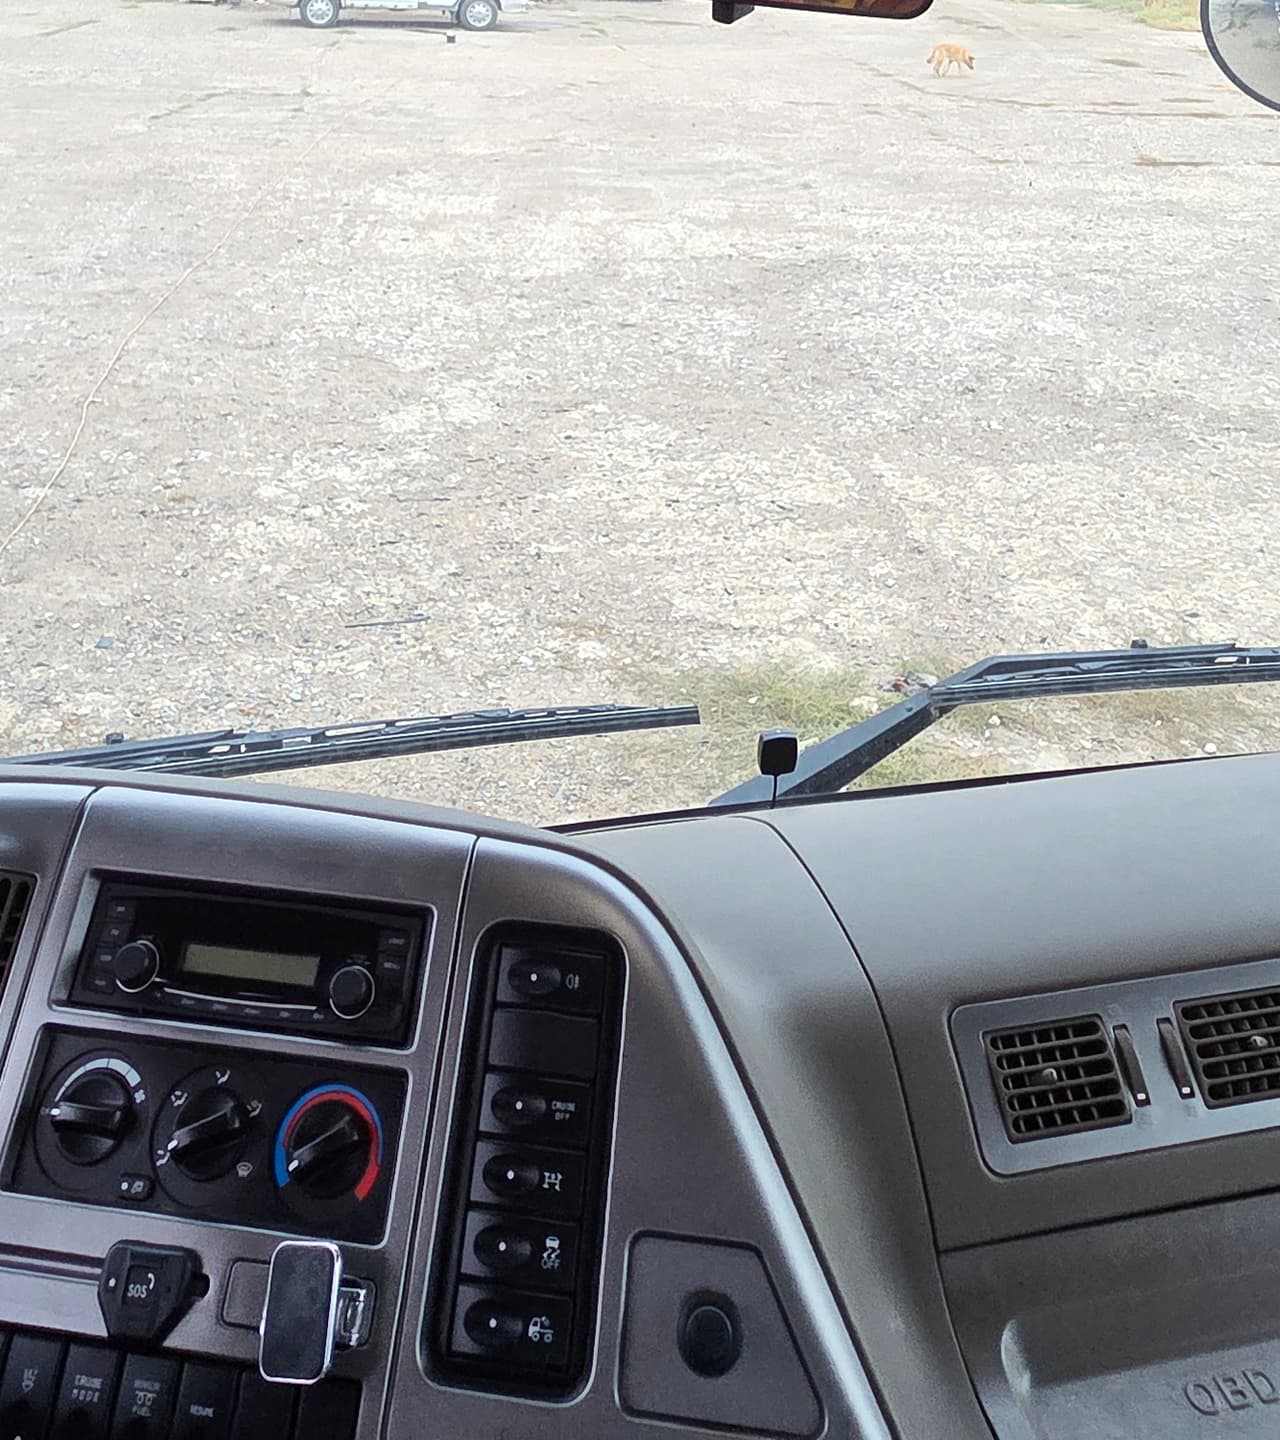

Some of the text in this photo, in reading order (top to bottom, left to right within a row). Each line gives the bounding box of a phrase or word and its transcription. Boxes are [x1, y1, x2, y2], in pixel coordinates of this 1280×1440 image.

[541, 1259, 561, 1270] OFF
[127, 1283, 148, 1299] SOS
[1184, 1370, 1280, 1417] OBD
